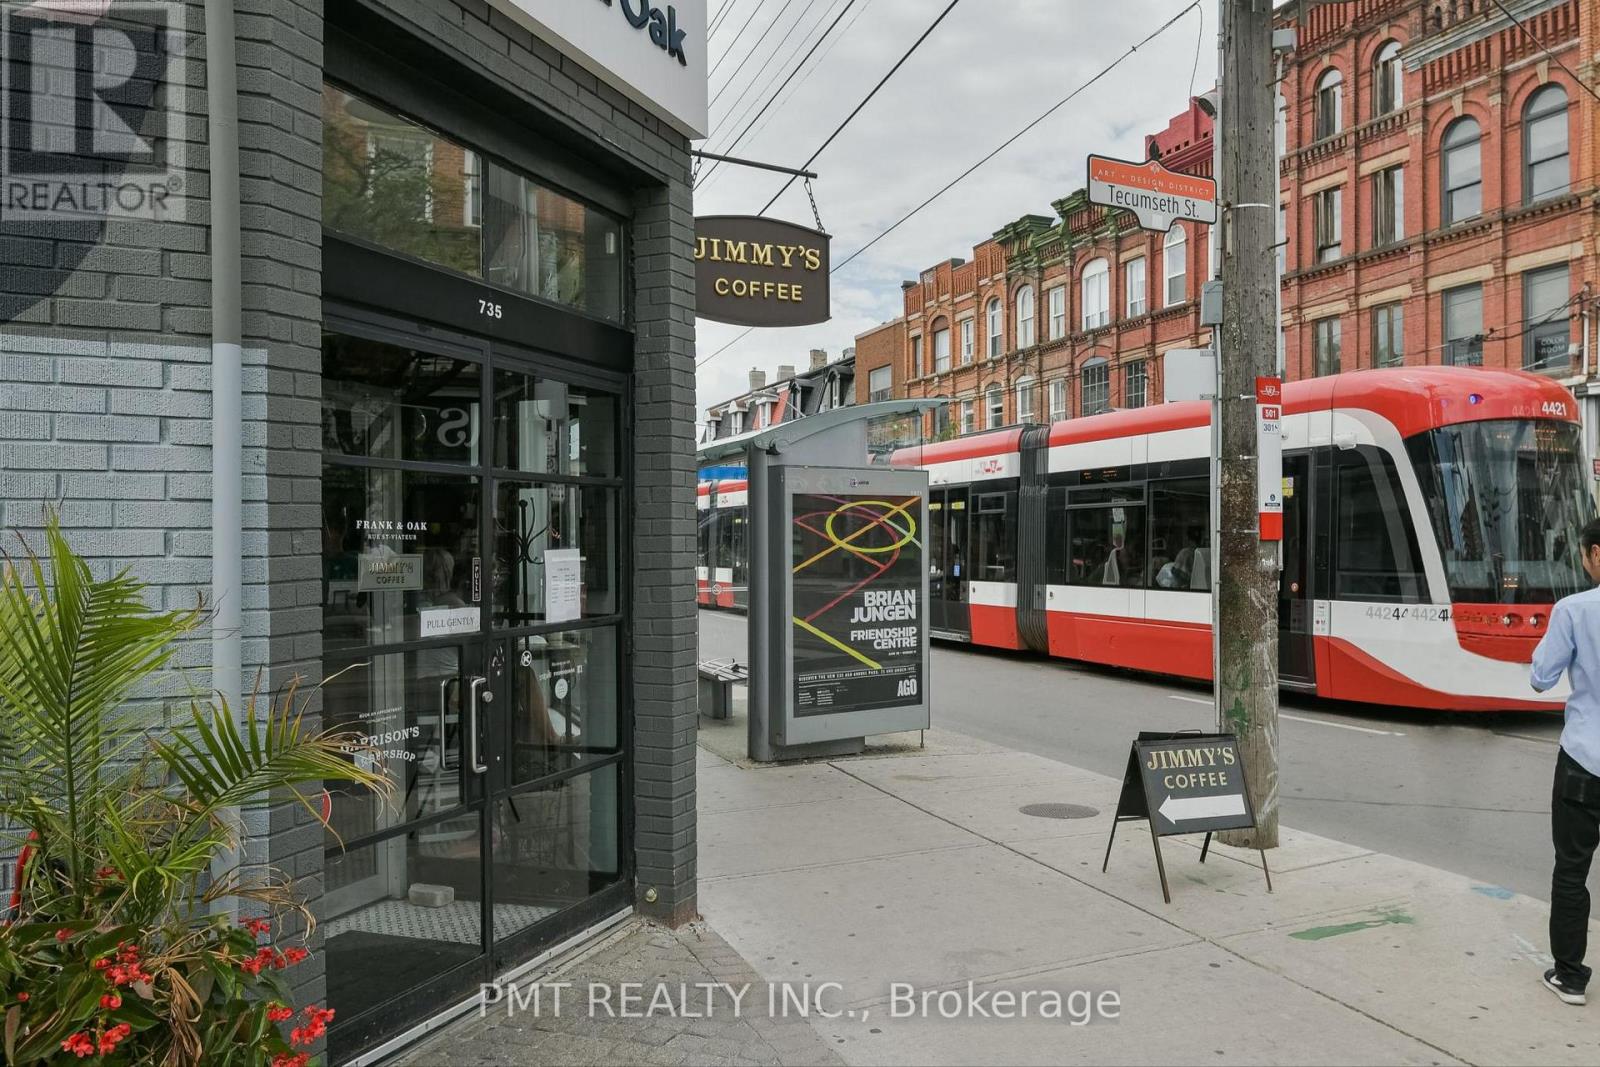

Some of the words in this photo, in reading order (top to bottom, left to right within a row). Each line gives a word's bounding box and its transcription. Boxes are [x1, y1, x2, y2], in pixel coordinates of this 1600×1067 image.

[1098, 169, 1115, 178] ART
[1130, 175, 1164, 187] DESIGN
[1169, 184, 1209, 195] DISTRICT
[1108, 185, 1179, 214] Tecumseth
[1184, 200, 1199, 218] St.
[694, 237, 820, 270] JIMMY'S
[715, 278, 802, 301] COFFEE
[479, 299, 502, 319] 735
[1265, 409, 1276, 418] 501
[1542, 401, 1567, 416] 4421
[356, 520, 393, 530] FRANK
[396, 522, 403, 530] &
[406, 521, 427, 531] OAK
[376, 576, 405, 584] COFFEE
[864, 589, 916, 607] BRIAN
[850, 605, 917, 623] JUNGEN
[427, 619, 445, 629] PULL
[850, 627, 917, 641] FRIENDSHIP
[873, 637, 917, 649] CENTRE
[897, 679, 917, 697] AGO
[1147, 746, 1235, 770] JIMMY'S
[1164, 772, 1228, 789] COFFEE
